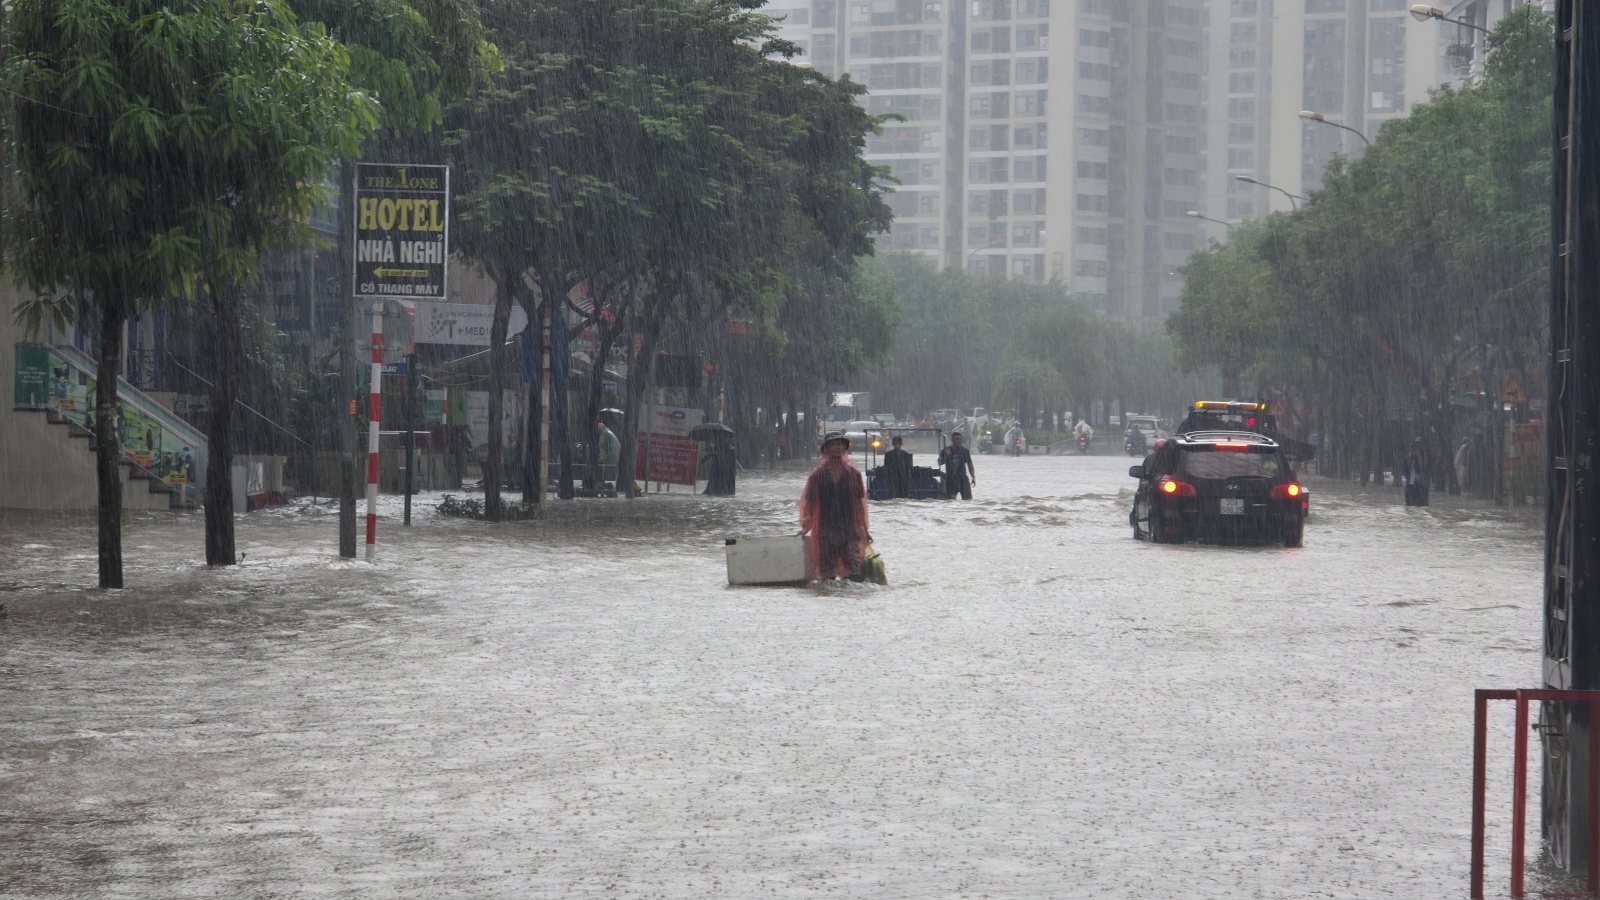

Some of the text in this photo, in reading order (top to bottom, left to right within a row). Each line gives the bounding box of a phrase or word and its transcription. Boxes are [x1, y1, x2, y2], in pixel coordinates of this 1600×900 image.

[365, 176, 393, 188] THE
[409, 177, 439, 189] ONE
[358, 197, 444, 232] HOTEL
[358, 233, 443, 264] NHÀ NGHỈ
[360, 281, 440, 295] CÓ THANG MÁY
